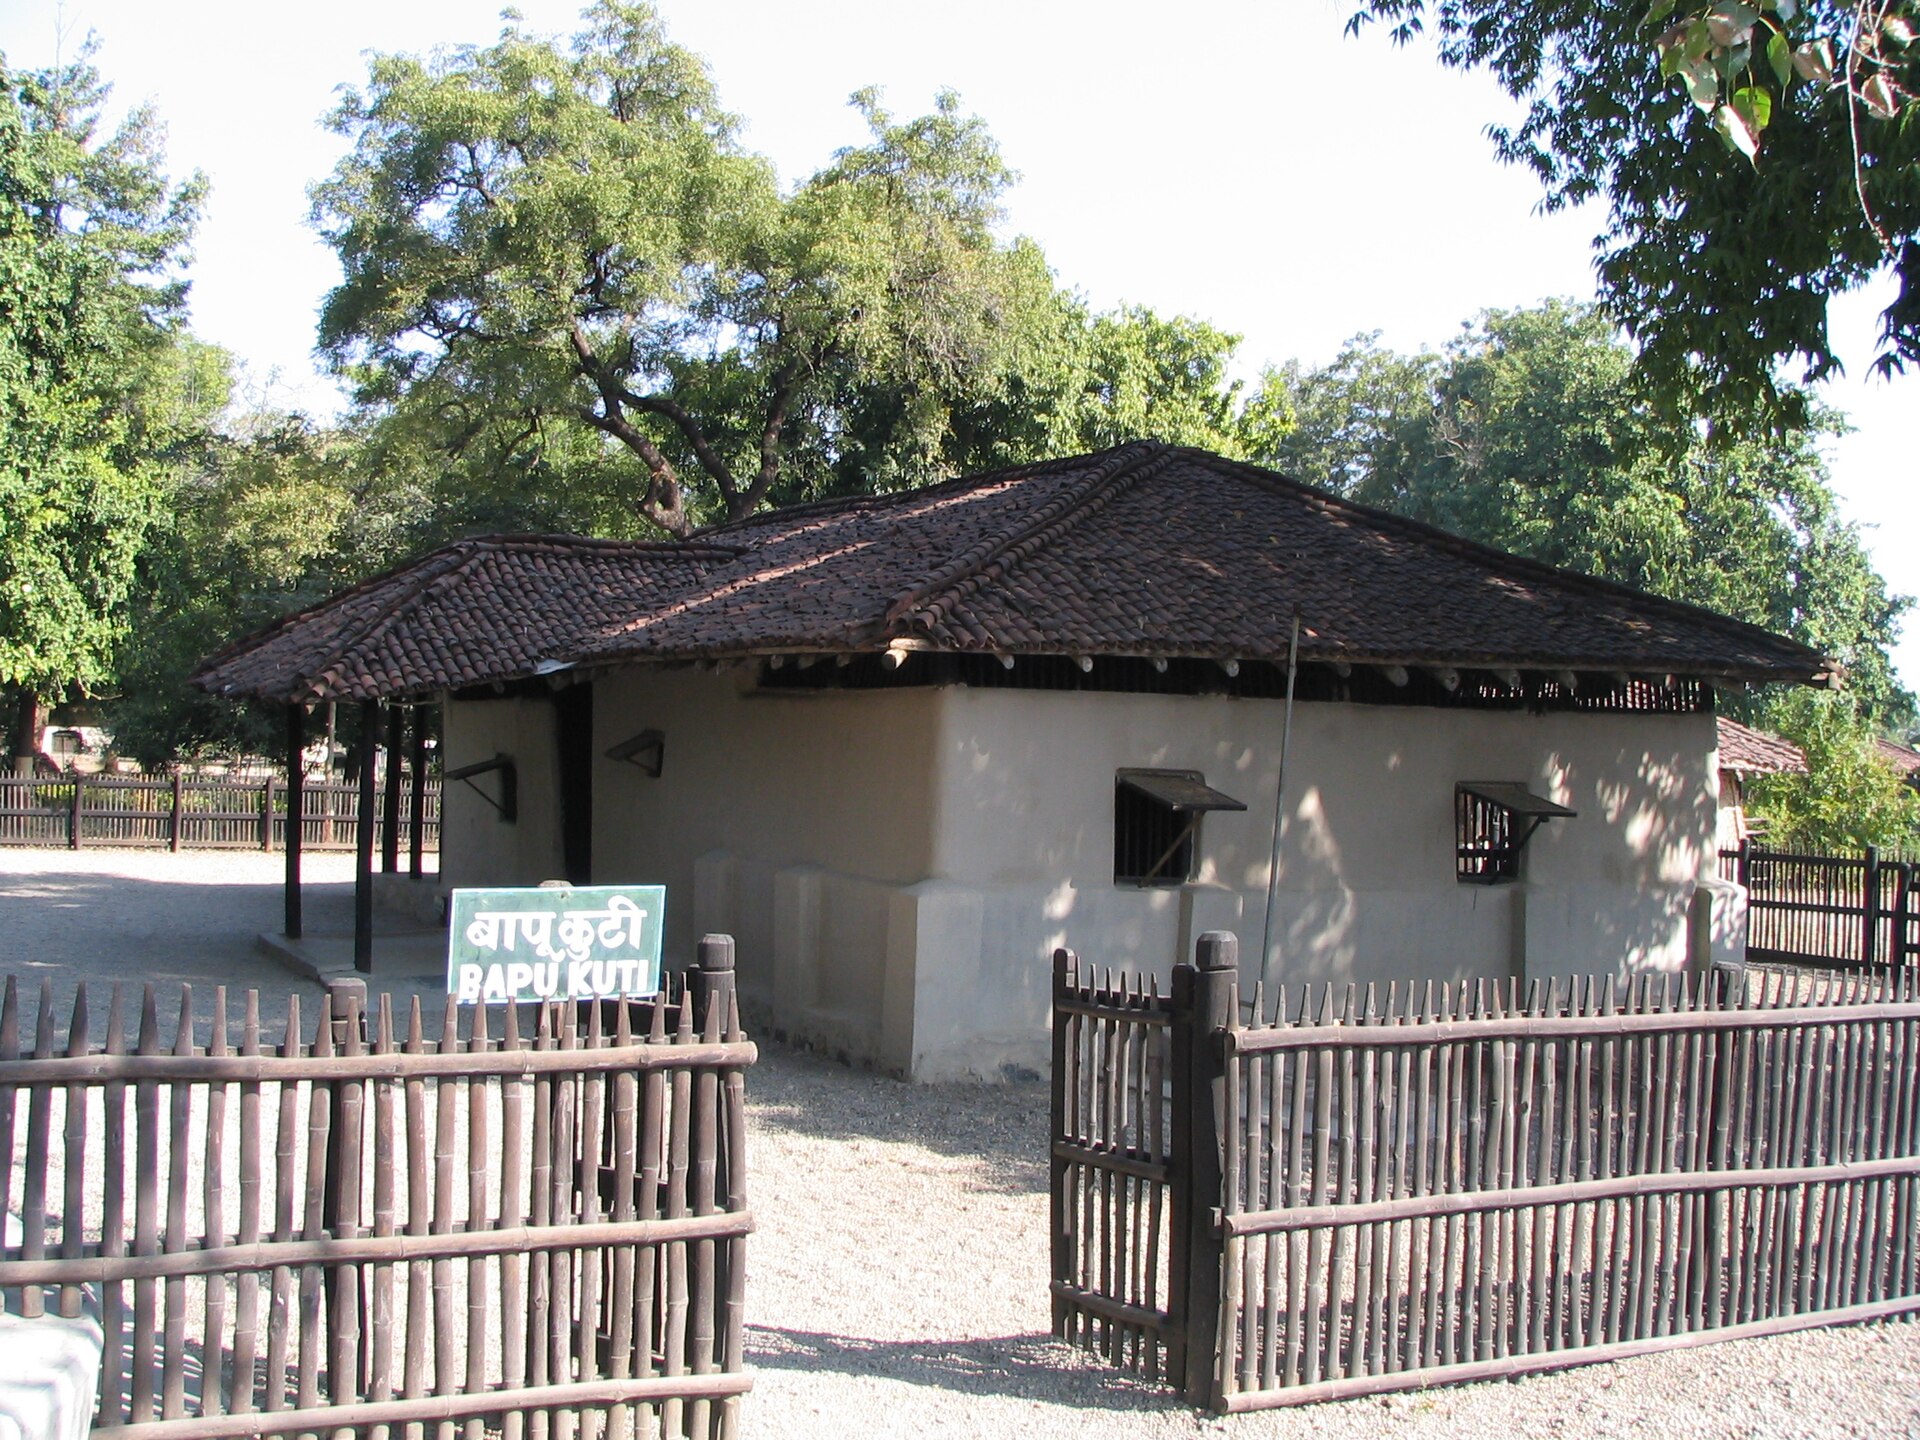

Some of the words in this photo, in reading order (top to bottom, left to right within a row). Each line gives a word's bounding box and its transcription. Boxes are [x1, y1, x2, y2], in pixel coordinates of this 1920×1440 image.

[466, 911, 566, 962] बापू
[558, 894, 648, 961] कुटी
[458, 961, 559, 999] BAPU
[567, 959, 649, 996] KUTI
